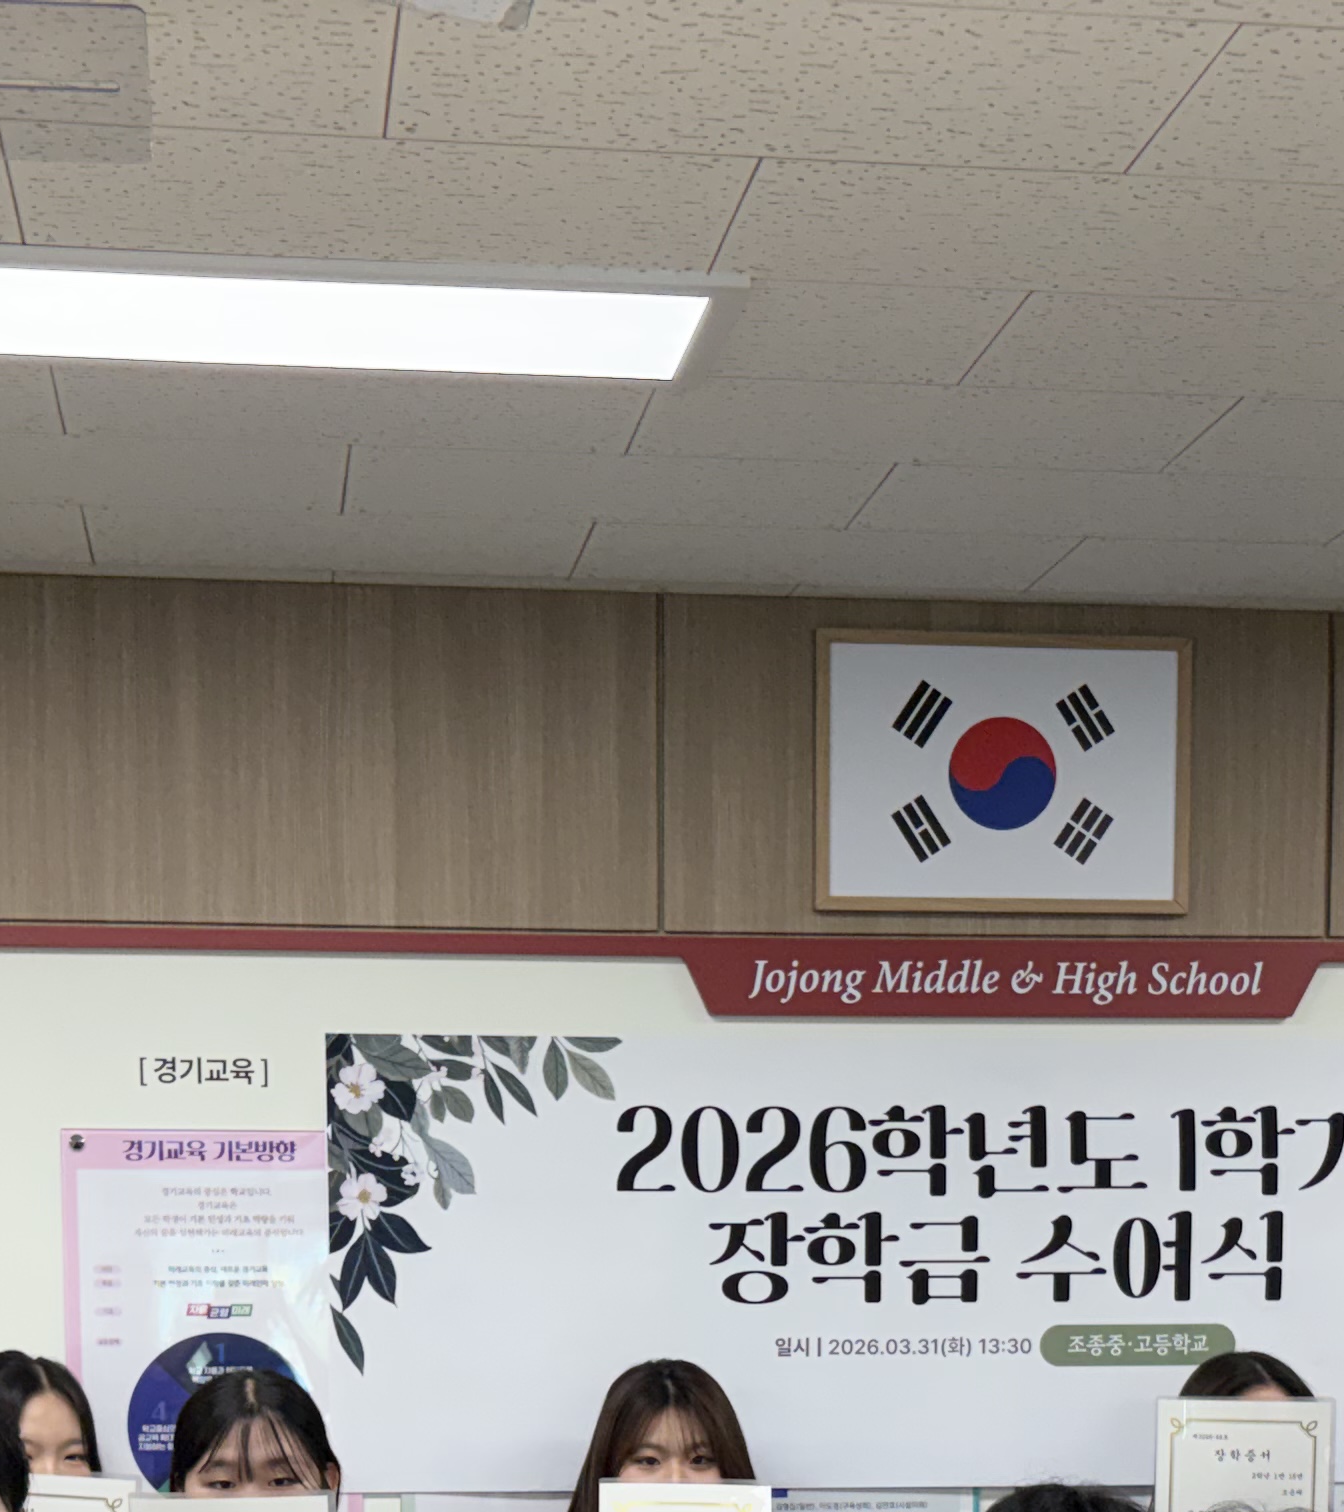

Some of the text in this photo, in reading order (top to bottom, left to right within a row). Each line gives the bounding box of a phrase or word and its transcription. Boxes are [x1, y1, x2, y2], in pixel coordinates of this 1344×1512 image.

[748, 959, 1264, 1004] Jojong Middle & High School
[122, 1140, 297, 1162] 경기교육 기본방향
[615, 1103, 1148, 1199] 2026학년도
[708, 1210, 1284, 1305] 장학금 수여식
[774, 1336, 811, 1358] 일시
[827, 1336, 973, 1359] 2026.03.31(화)
[978, 1337, 1032, 1357] 13:30
[1066, 1331, 1210, 1356] 조종중·고등학교
